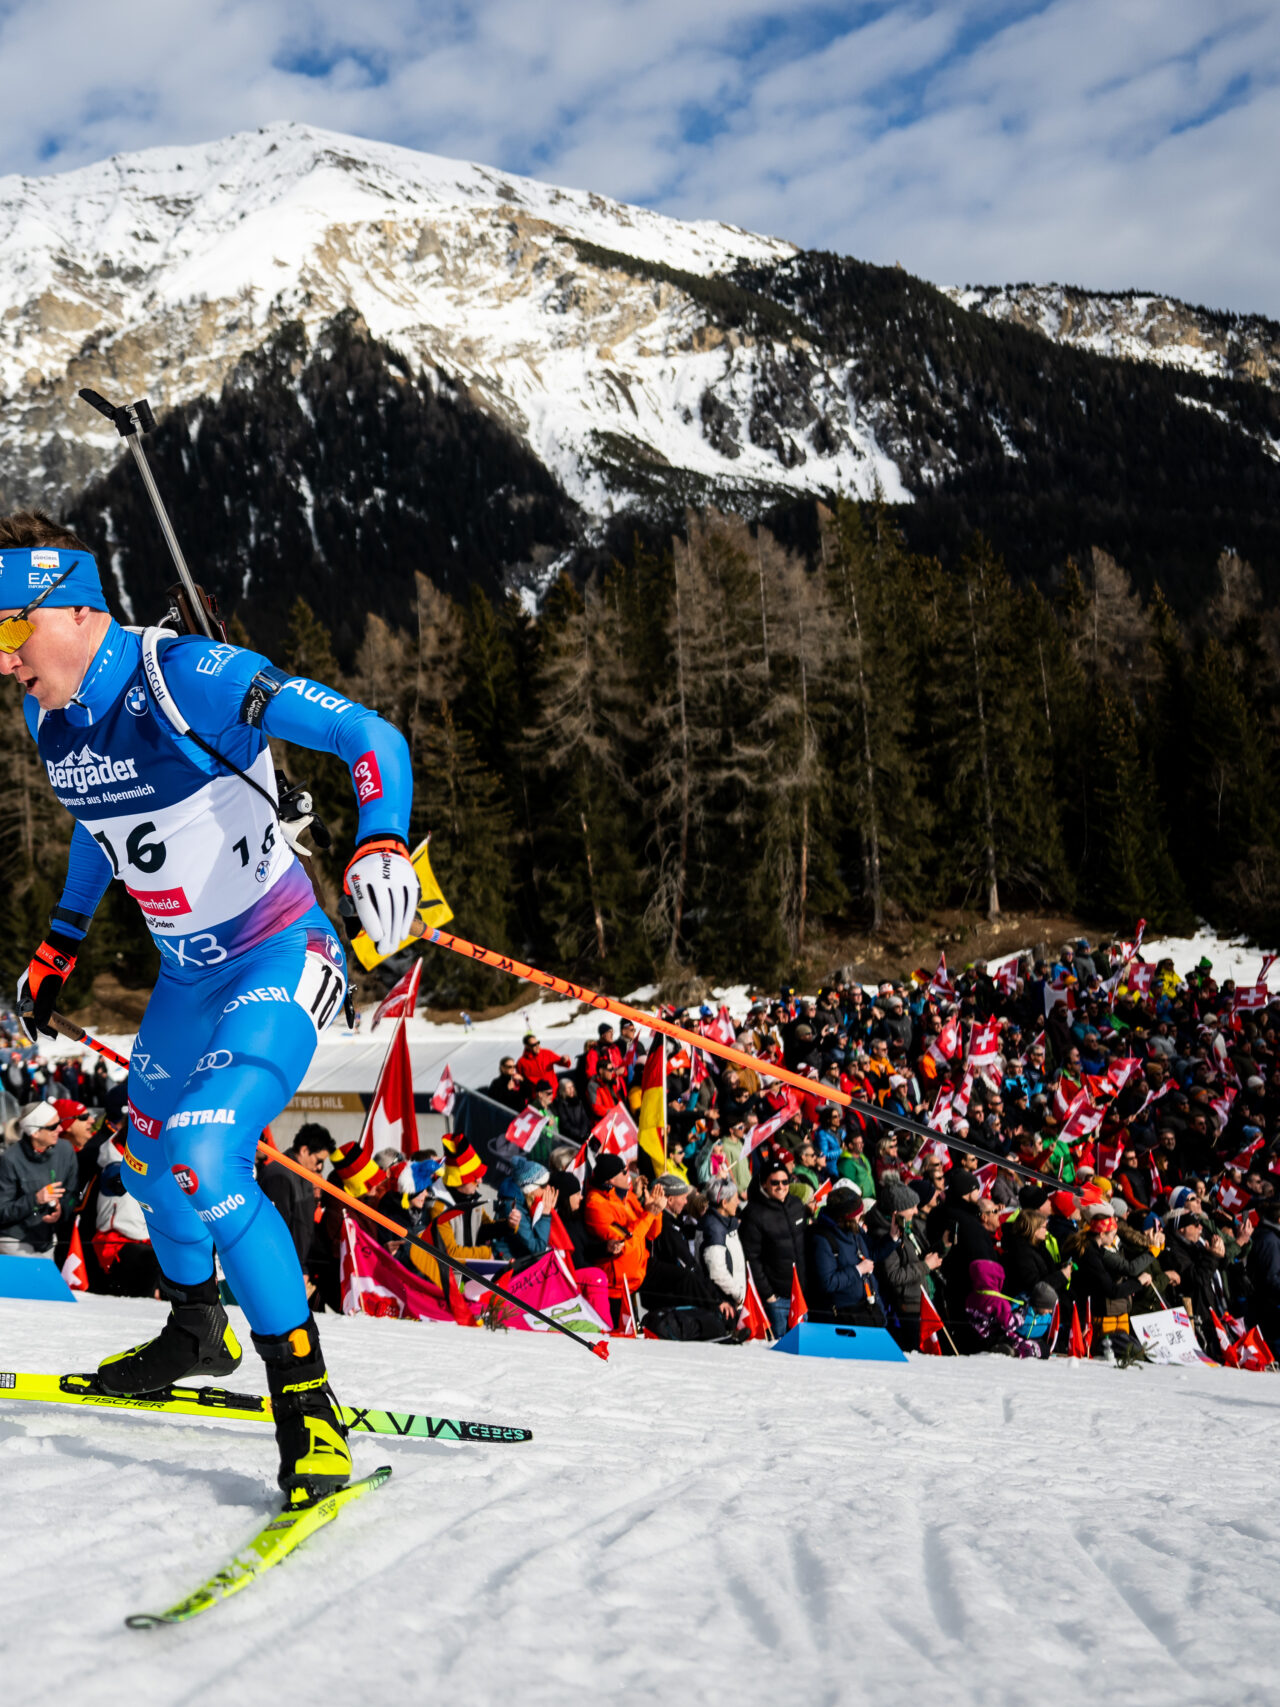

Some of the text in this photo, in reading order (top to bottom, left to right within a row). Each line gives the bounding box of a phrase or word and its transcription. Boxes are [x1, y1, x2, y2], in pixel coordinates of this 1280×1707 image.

[144, 651, 166, 702] FIOCCHI
[283, 676, 355, 714] Audi
[46, 756, 139, 794] Bergader
[86, 796, 102, 804] aus
[102, 784, 156, 804] Alpenmilch
[354, 761, 381, 801] enel
[93, 821, 167, 876] 16
[232, 822, 276, 868] 16
[218, 987, 291, 1024] ONERI
[310, 965, 343, 1031] 16
[322, 1096, 344, 1109] HILL
[81, 1397, 165, 1410] FISCHER
[348, 1407, 525, 1441] SPEED MAX
